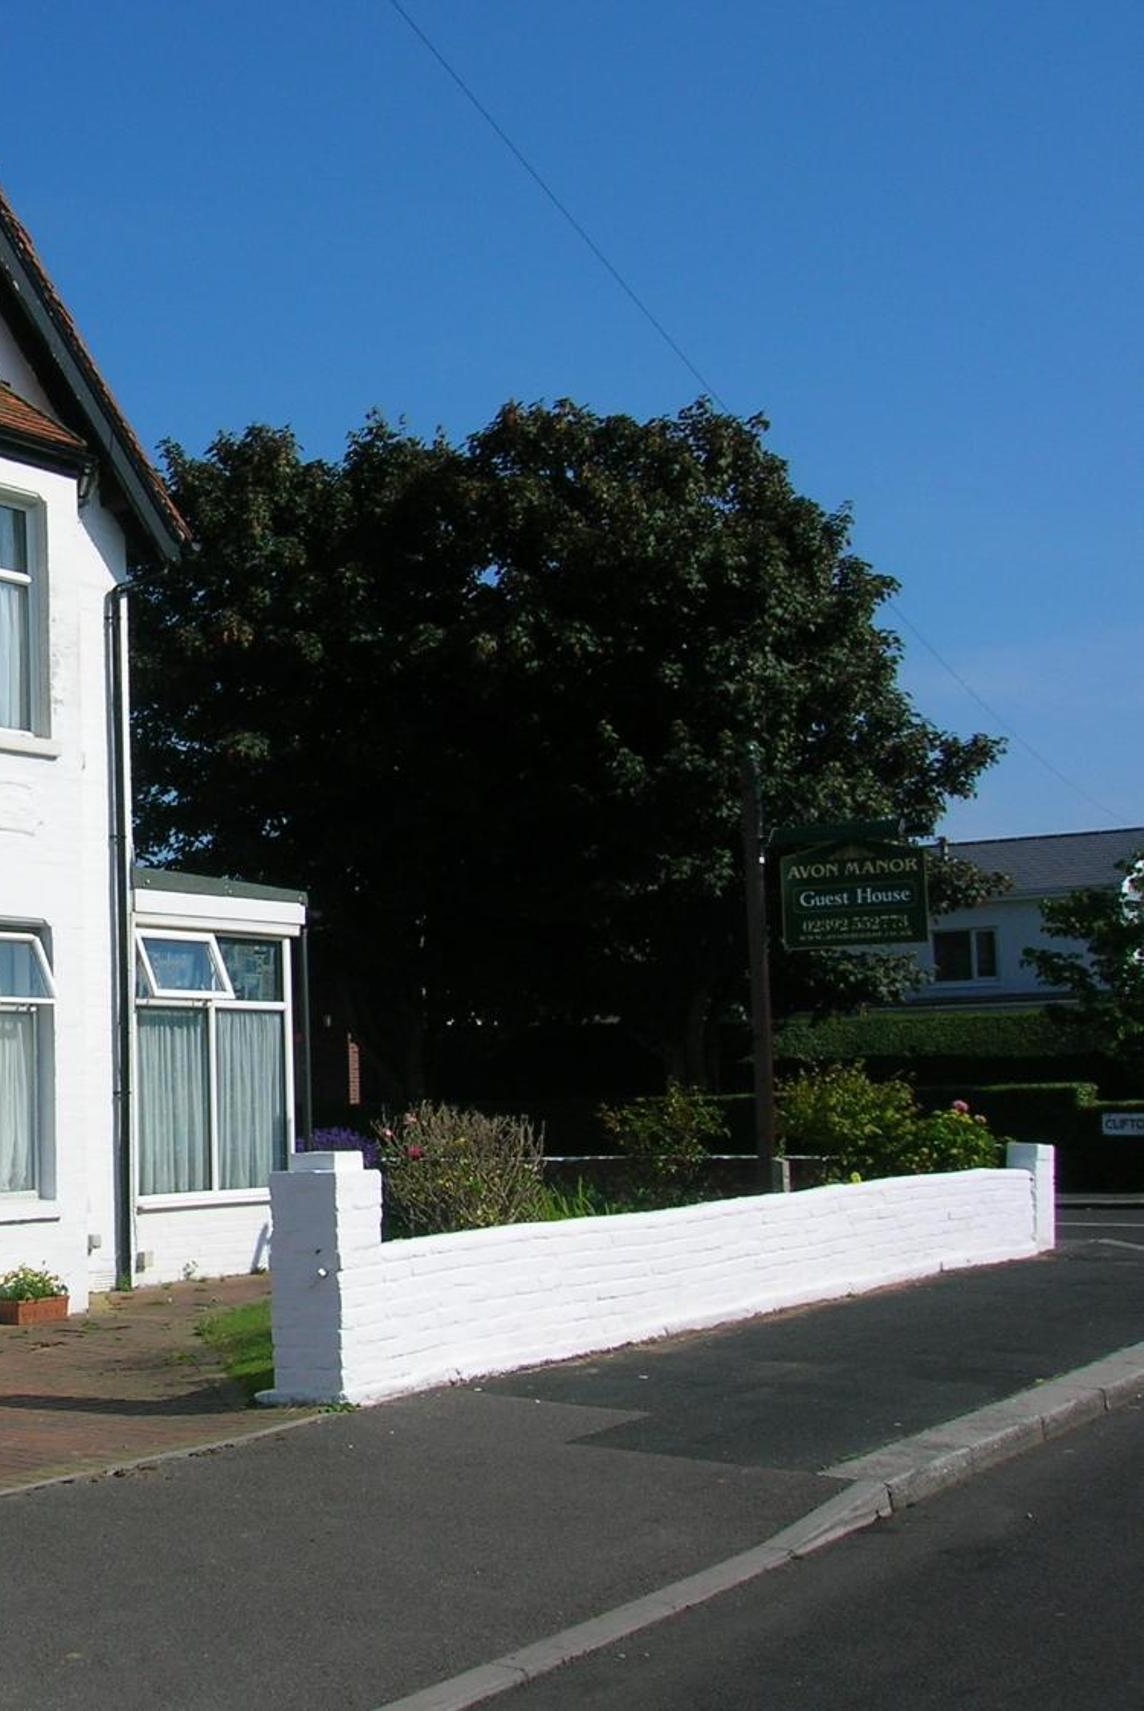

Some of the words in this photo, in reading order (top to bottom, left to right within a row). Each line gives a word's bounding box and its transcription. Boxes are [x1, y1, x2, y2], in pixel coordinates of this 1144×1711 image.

[787, 863, 839, 880] AVON
[844, 857, 919, 876] MANOR
[799, 891, 849, 908] Guest
[856, 887, 913, 905] House
